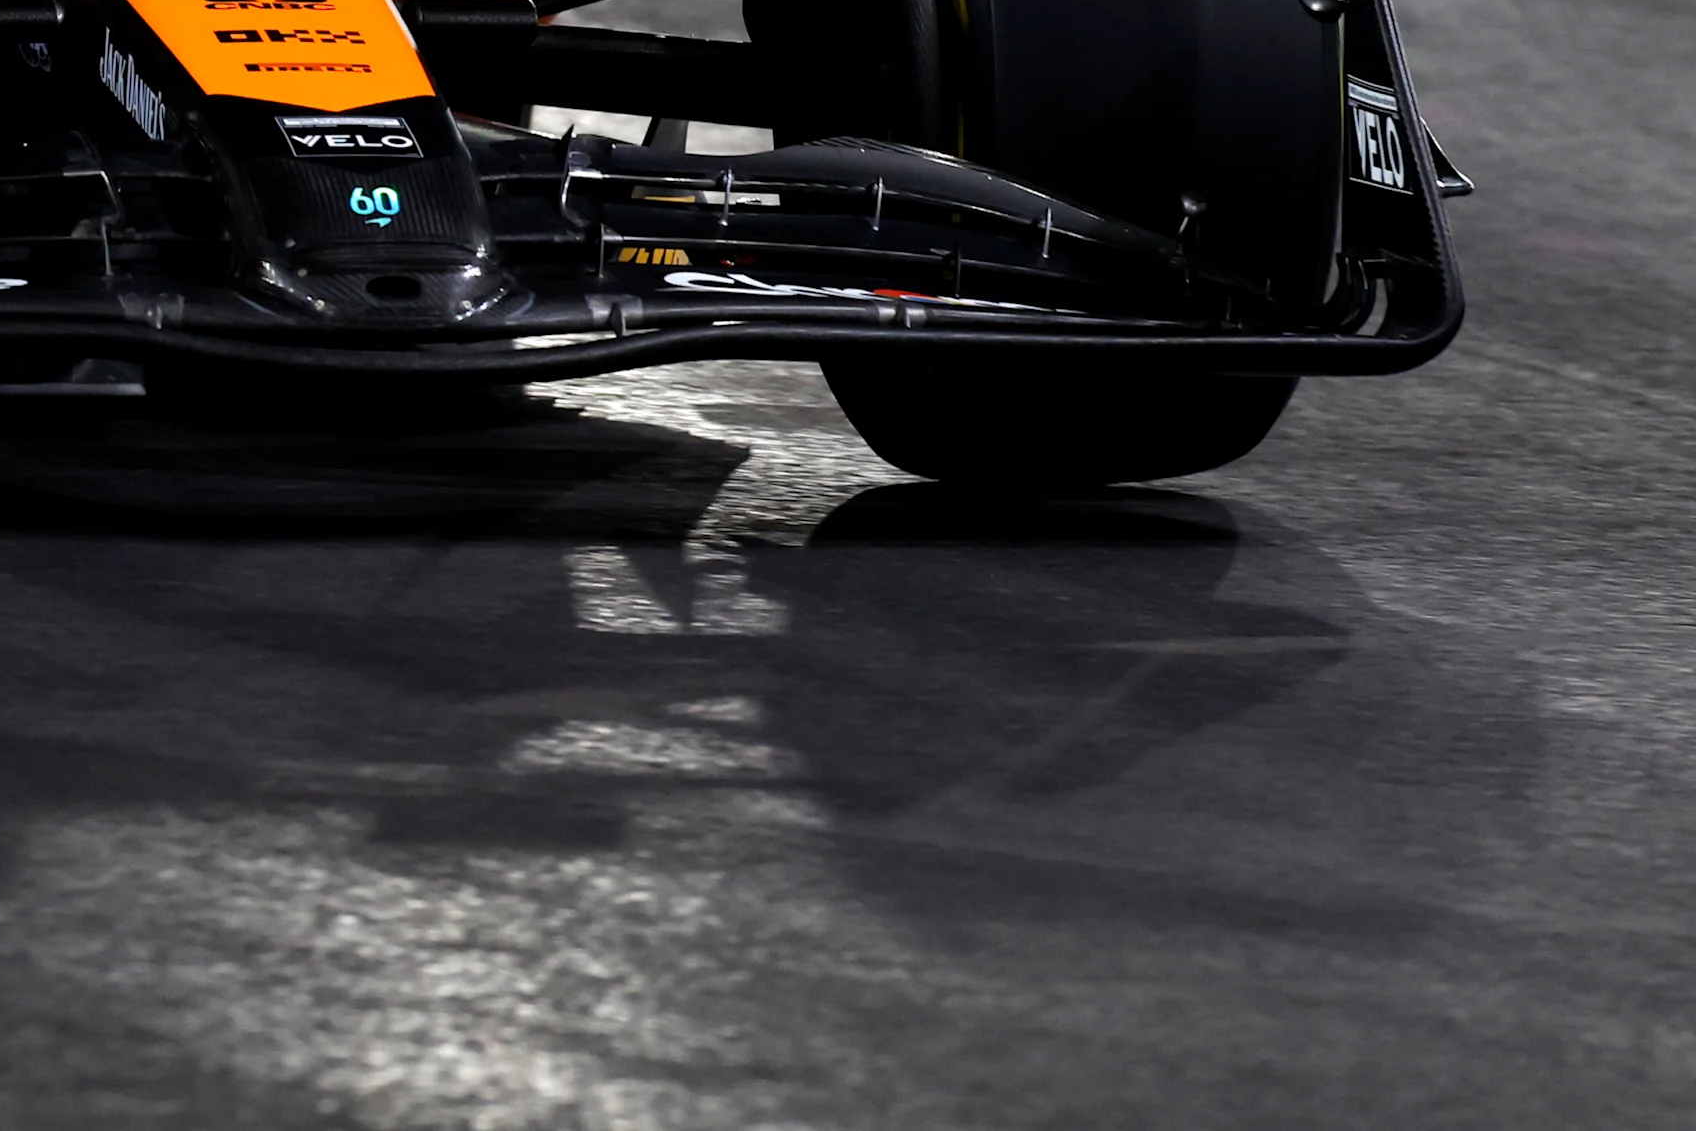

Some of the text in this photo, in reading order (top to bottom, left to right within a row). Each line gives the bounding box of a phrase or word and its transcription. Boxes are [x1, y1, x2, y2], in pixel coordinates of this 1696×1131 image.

[204, 2, 336, 11] CNBC
[100, 26, 126, 106] JACK
[290, 134, 414, 149] VELO
[1352, 106, 1404, 189] VELO
[349, 186, 401, 216] 60
